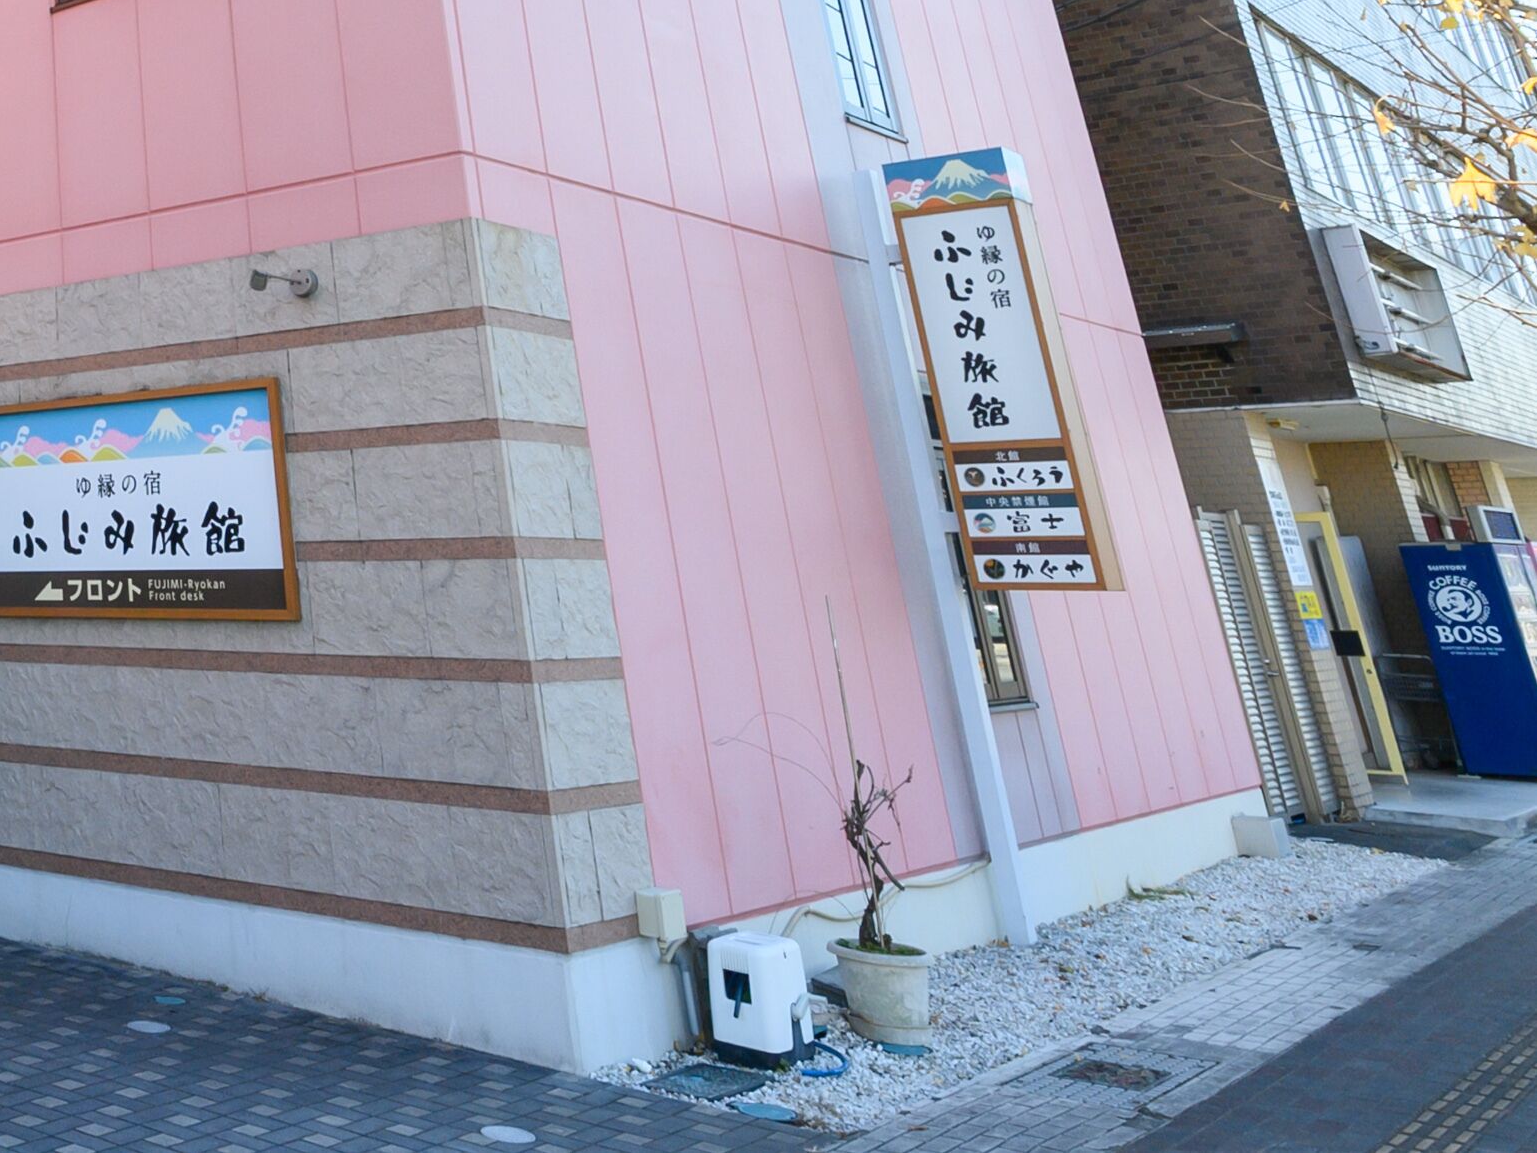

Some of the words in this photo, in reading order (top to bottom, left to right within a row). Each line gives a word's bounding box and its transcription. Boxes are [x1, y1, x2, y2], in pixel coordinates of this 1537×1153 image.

[976, 225, 1012, 309] ゆ縁の宿
[933, 229, 1010, 429] ふじみ旅館
[995, 450, 1020, 462] 北館
[76, 470, 162, 498] ゆ縁の宿
[991, 465, 1064, 487] ふくろう
[985, 495, 1050, 508] 中央禁煙館
[12, 501, 246, 559] ふじみ旅館
[1006, 511, 1064, 533] 富士
[1013, 559, 1084, 580] かぐや
[67, 578, 142, 603] フロント
[147, 578, 226, 592] FUJIMI-Ryokan
[1428, 575, 1478, 591] COFFEE
[148, 590, 176, 601] Front
[180, 590, 205, 601] desk
[1434, 625, 1503, 644] BOSS
